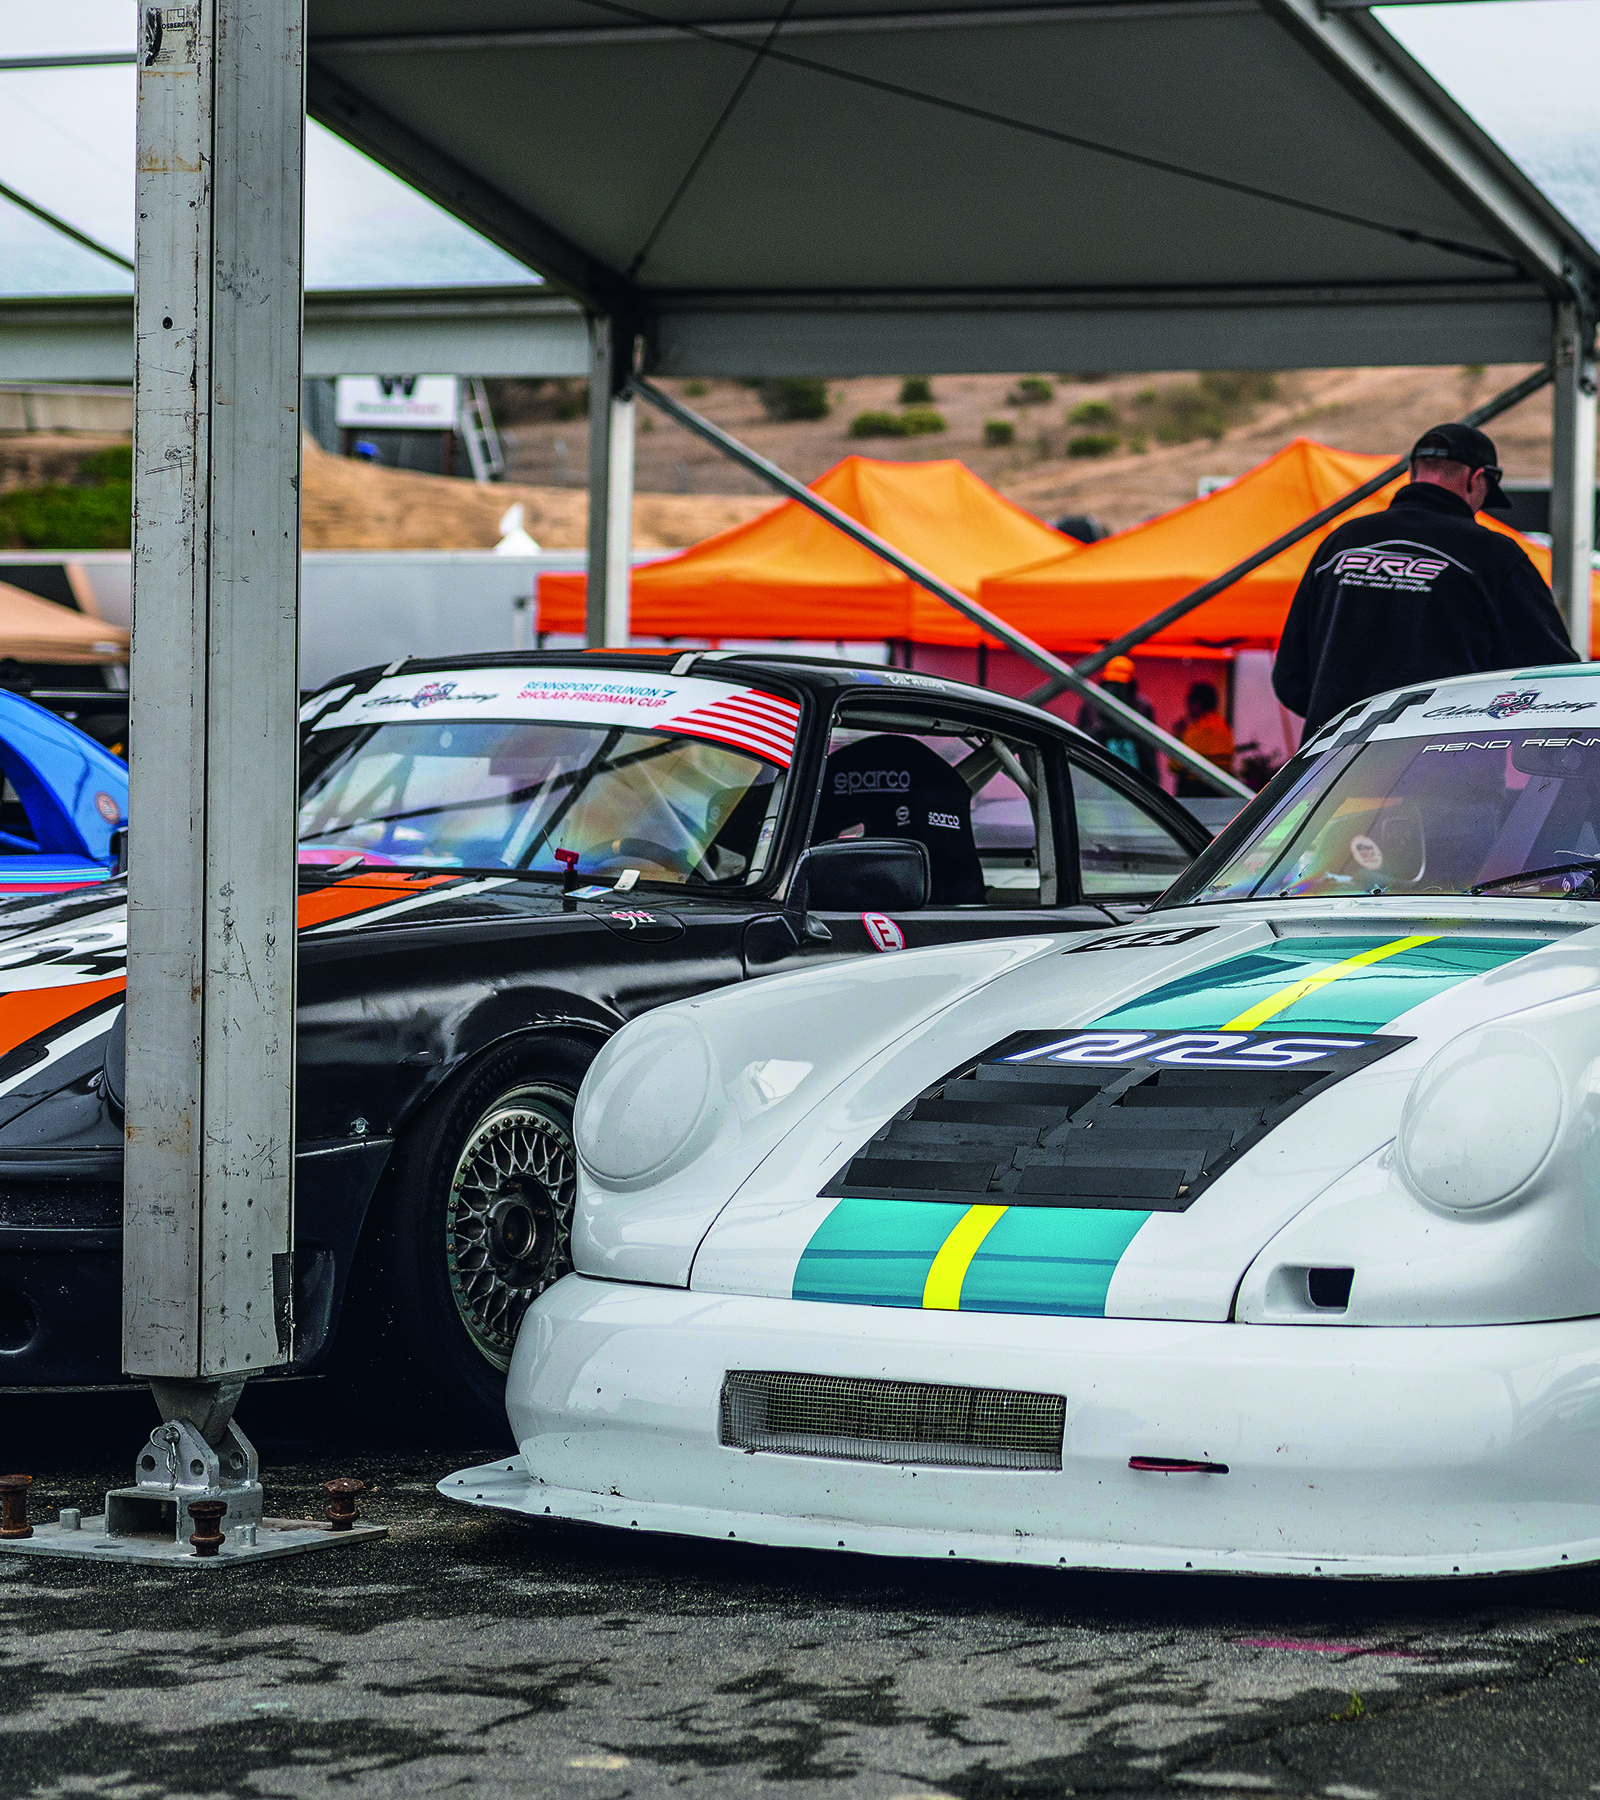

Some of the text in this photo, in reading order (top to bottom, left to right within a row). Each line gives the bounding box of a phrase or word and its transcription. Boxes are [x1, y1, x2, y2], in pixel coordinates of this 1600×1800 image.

[516, 690, 667, 708] SHOLAR-FRIEDMAN CUP
[524, 681, 678, 698] RENNSPORT REUNION 7
[1422, 740, 1512, 754] RENO
[833, 770, 911, 795] sparco
[927, 811, 961, 830] sparco
[872, 918, 898, 948] E
[1085, 928, 1197, 950] 44
[992, 1033, 1376, 1067] RRS
